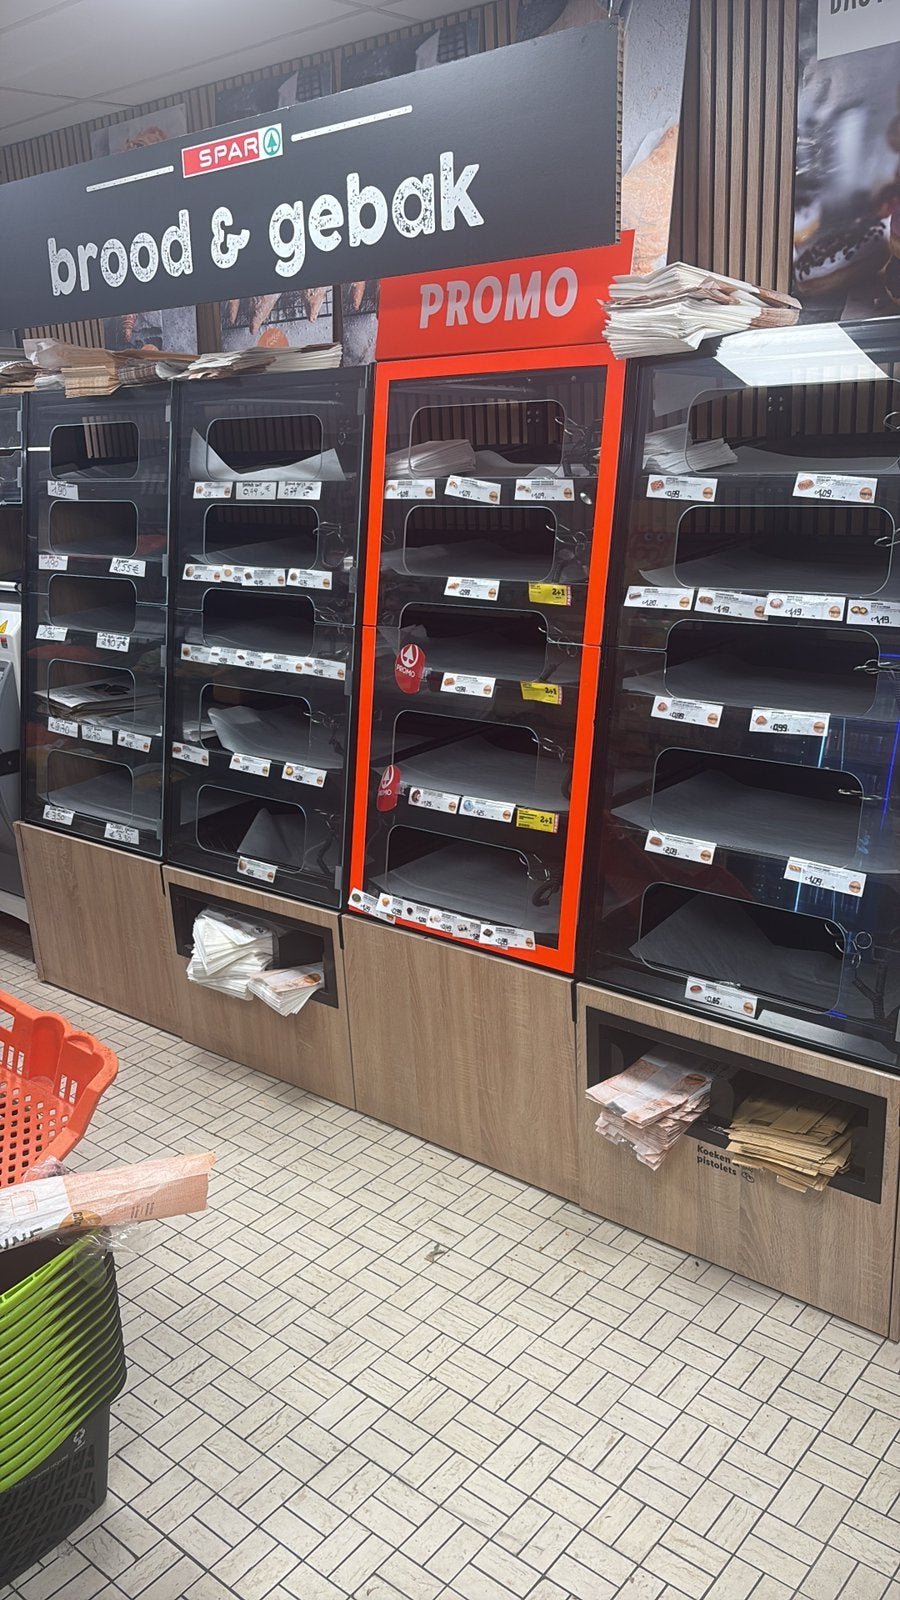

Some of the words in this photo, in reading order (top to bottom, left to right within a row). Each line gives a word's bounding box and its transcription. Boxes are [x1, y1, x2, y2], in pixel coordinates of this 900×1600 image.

[199, 137, 258, 168] SPAR
[47, 209, 194, 296] brood
[210, 206, 250, 269] &
[268, 151, 485, 278] gebak
[419, 267, 578, 329] PROMO
[552, 588, 565, 596] 2+1
[396, 664, 416, 678] PROMO
[545, 687, 557, 695] 2+1
[540, 815, 552, 824] 2+1
[697, 1145, 731, 1164] Koeken
[697, 1156, 737, 1175] pistolets
